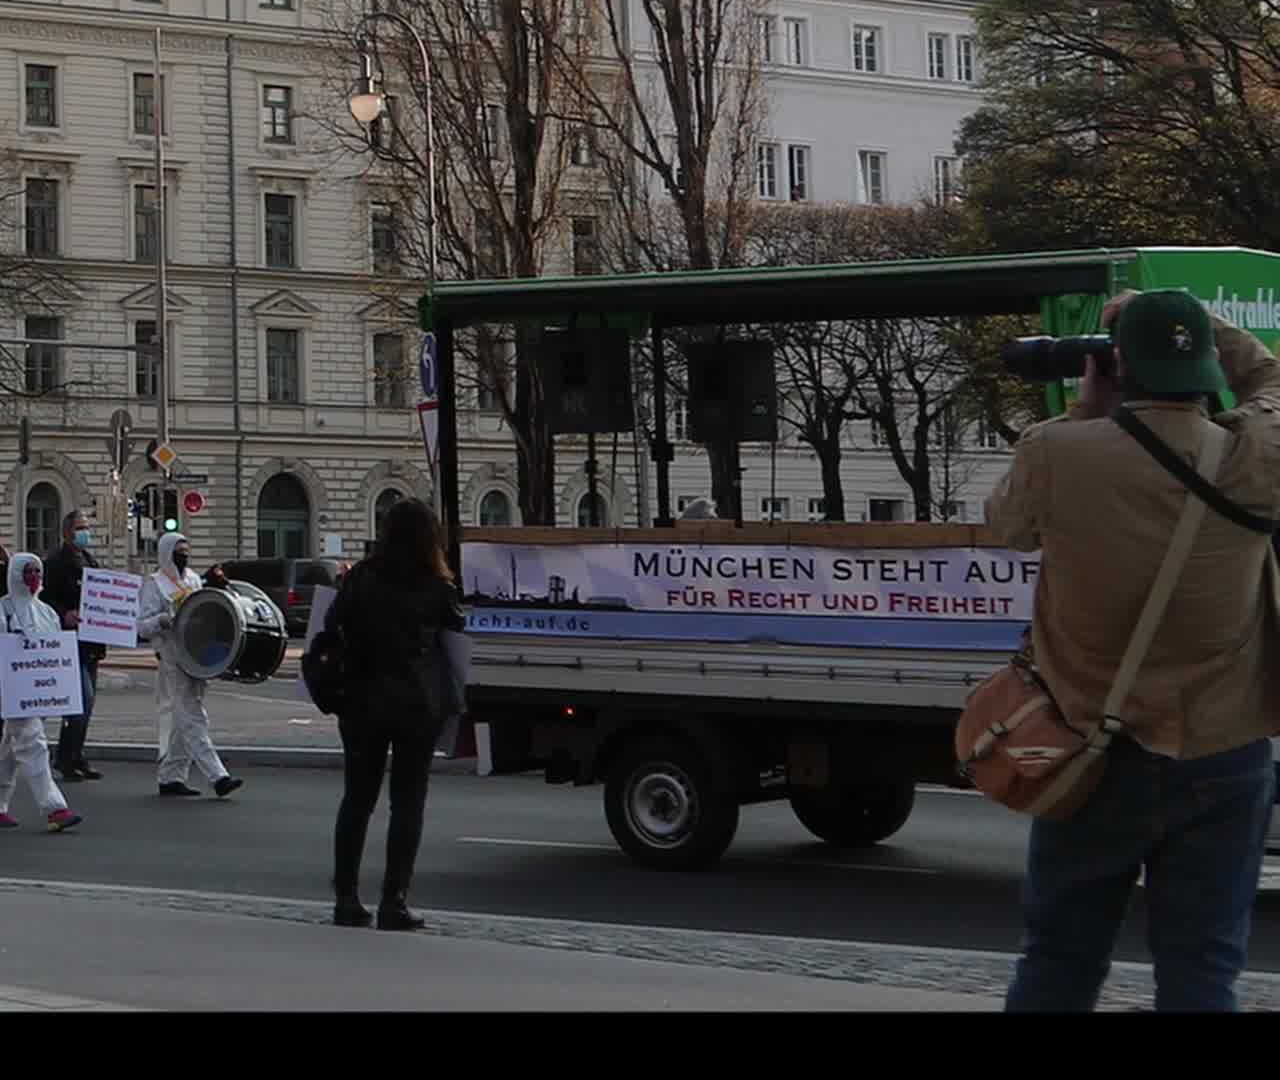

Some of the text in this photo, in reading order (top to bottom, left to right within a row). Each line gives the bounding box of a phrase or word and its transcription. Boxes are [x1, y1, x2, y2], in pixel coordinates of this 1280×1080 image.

[634, 548, 1040, 585] MÜNCHEN STEHT AUF
[667, 586, 1014, 615] FÜR RECHT UND FREIHEIT
[464, 611, 591, 632] teht-auf.de
[23, 639, 61, 650] Zu Tode
